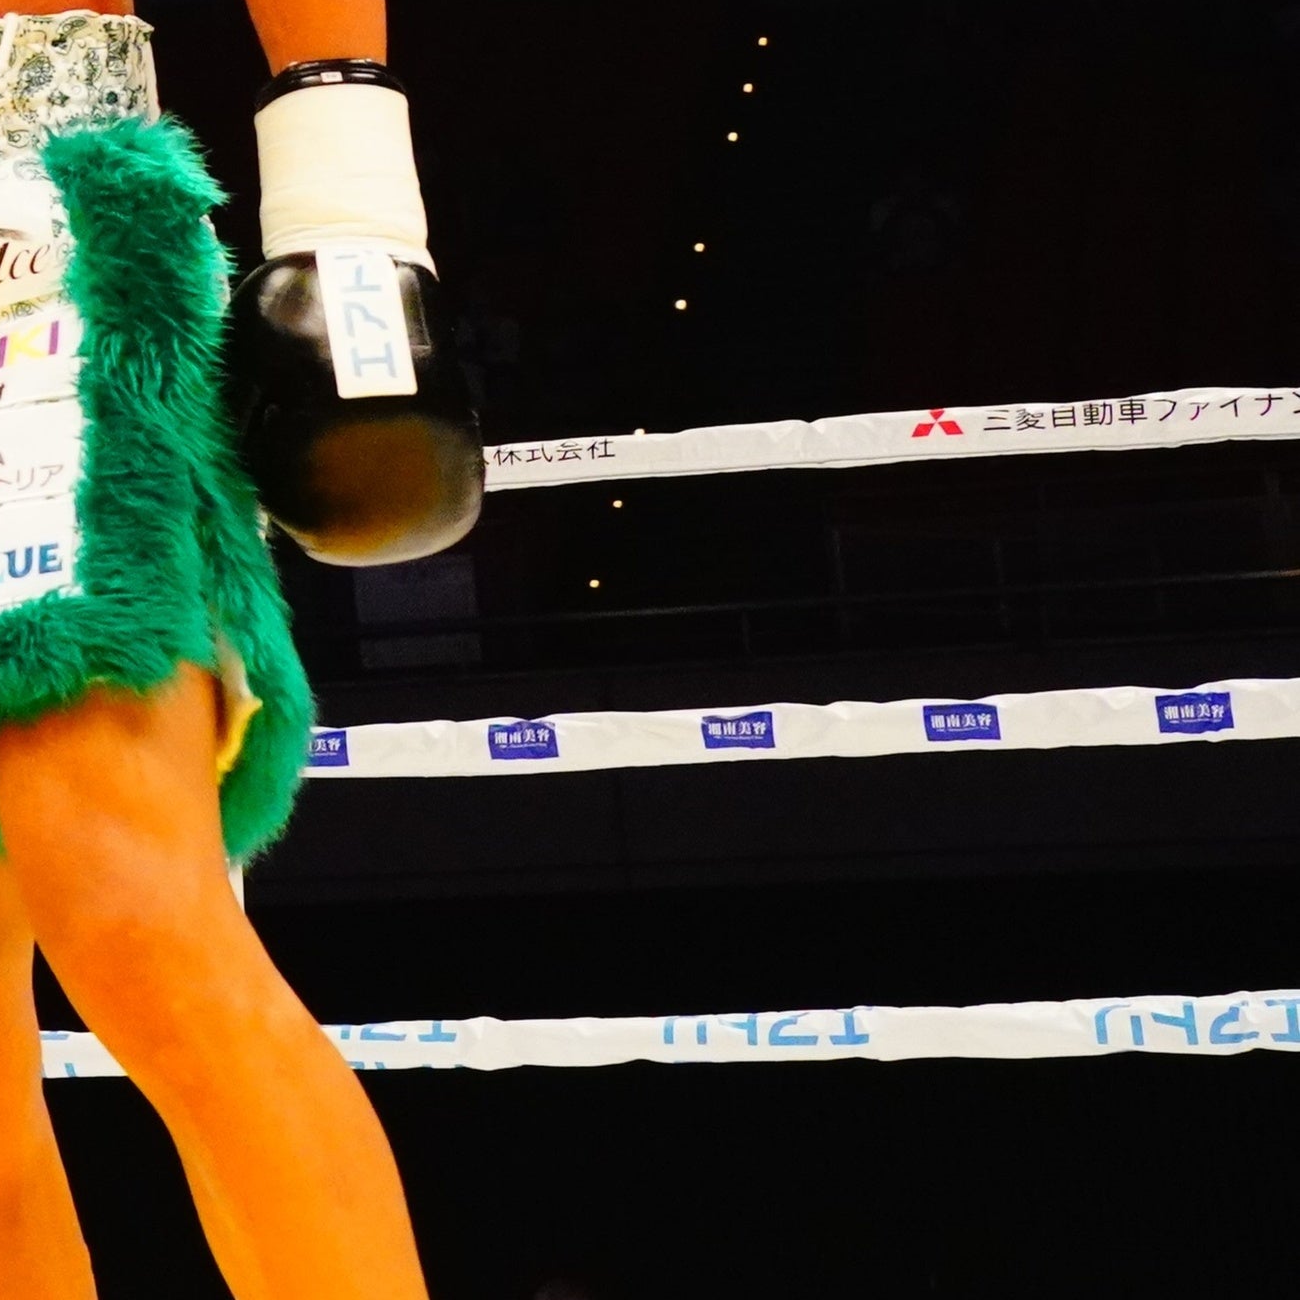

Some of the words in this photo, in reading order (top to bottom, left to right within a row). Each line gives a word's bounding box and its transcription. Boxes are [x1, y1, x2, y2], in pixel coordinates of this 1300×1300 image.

[708, 721, 767, 736] 湘南美容
[309, 737, 341, 751] 美容
